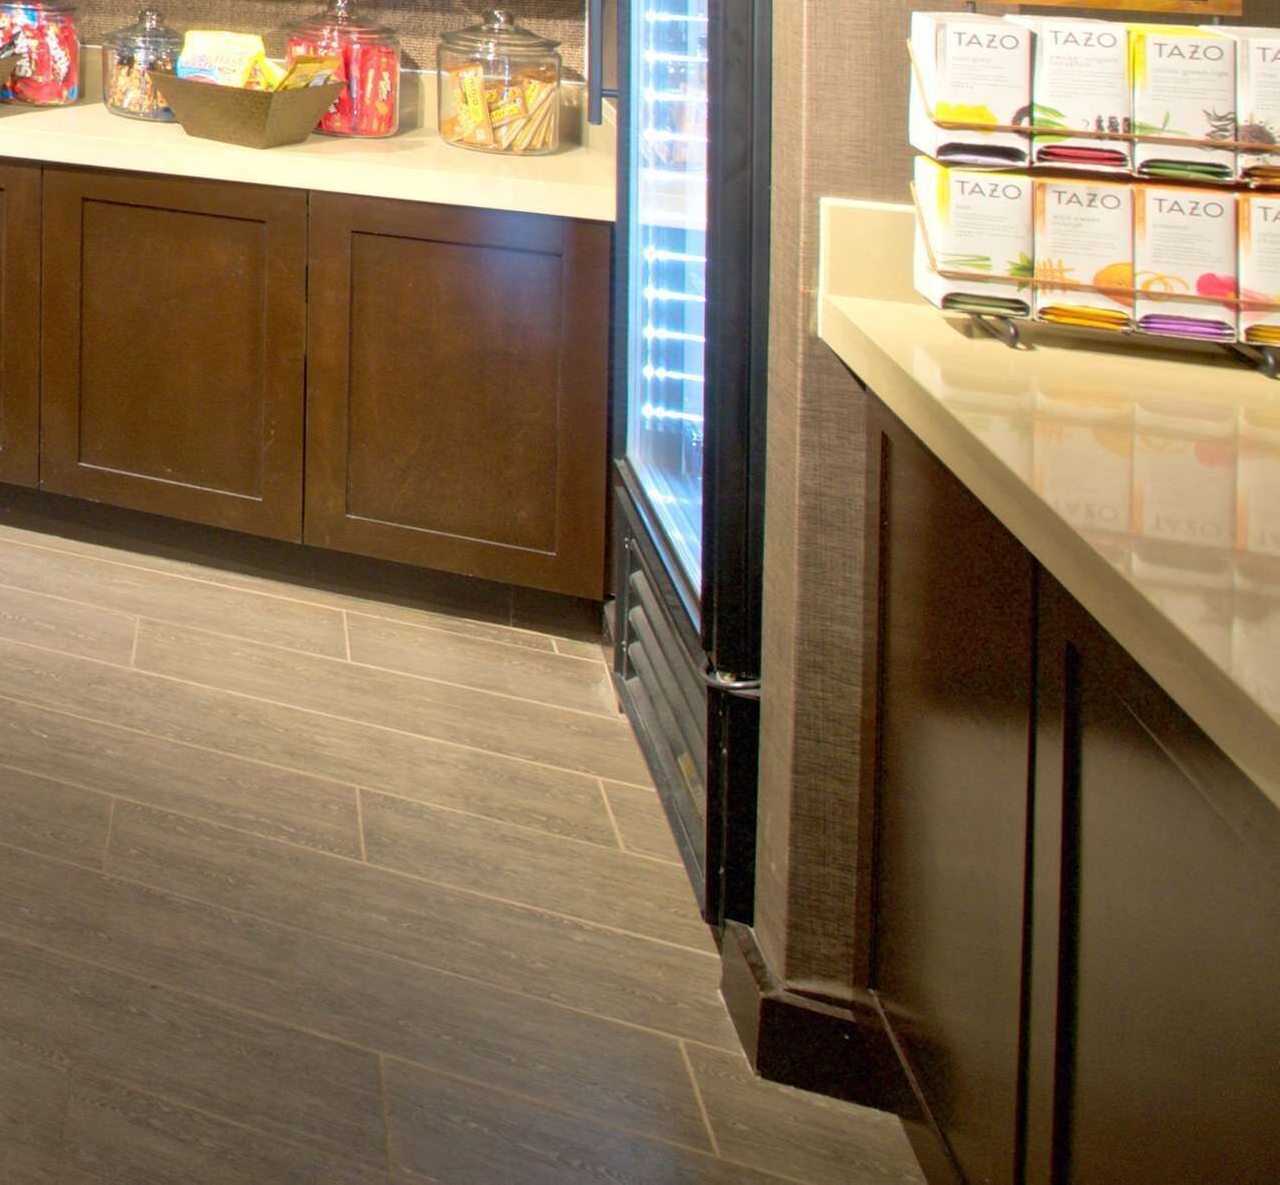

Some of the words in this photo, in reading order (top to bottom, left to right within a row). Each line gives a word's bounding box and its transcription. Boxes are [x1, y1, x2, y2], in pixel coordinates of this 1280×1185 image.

[953, 31, 1020, 50] TAZO
[1049, 29, 1118, 48] TAZO
[1153, 42, 1224, 62] TAZO
[955, 180, 1022, 200] TAZO
[1052, 190, 1121, 210] TAZO
[1153, 197, 1224, 218] TAZO
